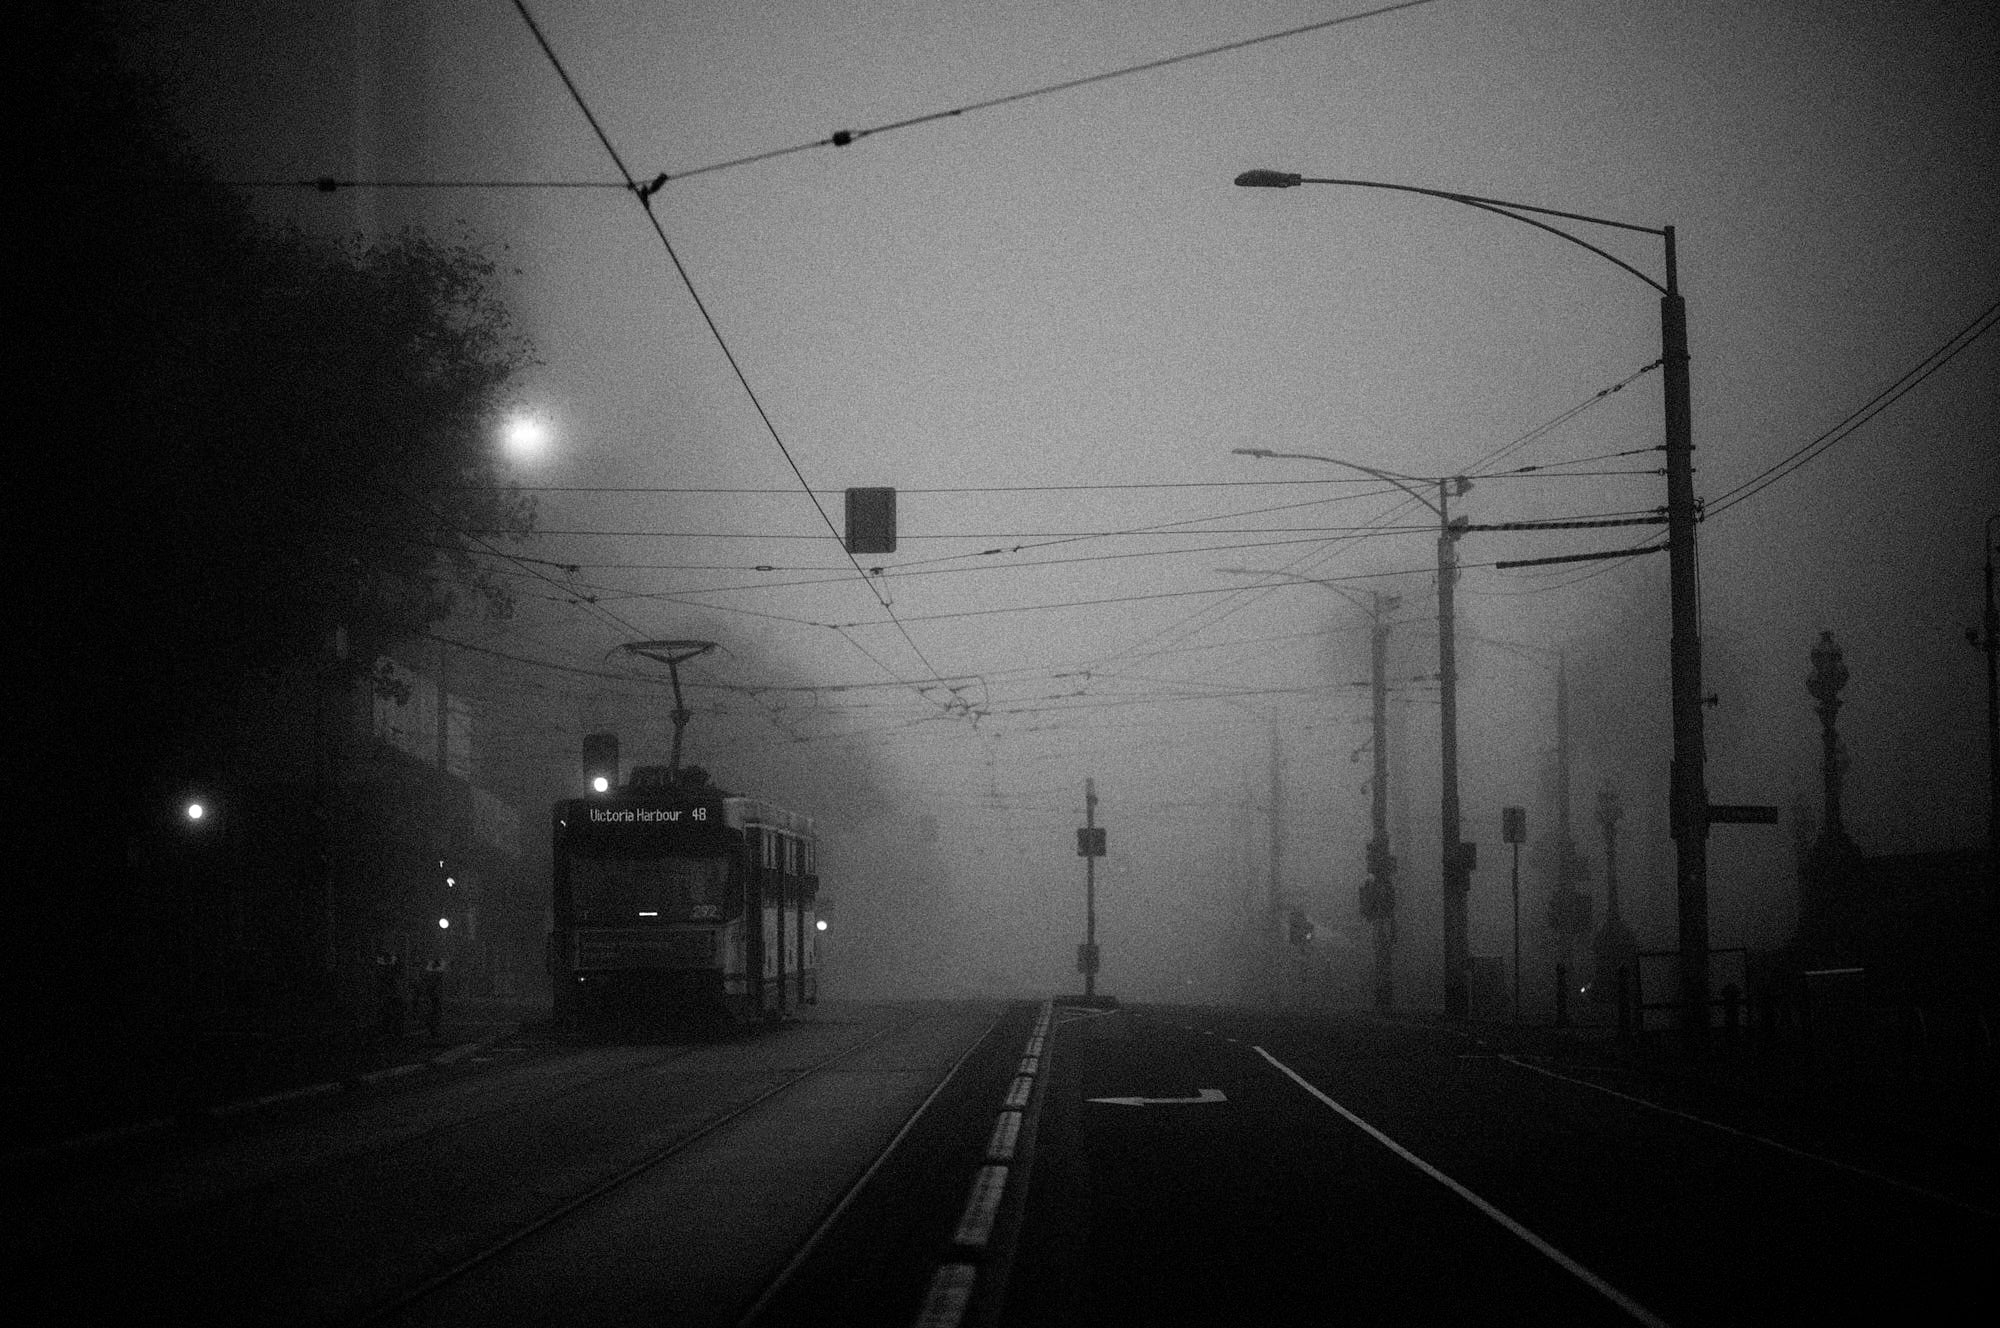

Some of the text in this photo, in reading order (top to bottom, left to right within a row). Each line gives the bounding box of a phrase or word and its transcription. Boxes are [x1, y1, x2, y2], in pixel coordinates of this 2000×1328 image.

[590, 807, 707, 822] Victoria Harbour 48
